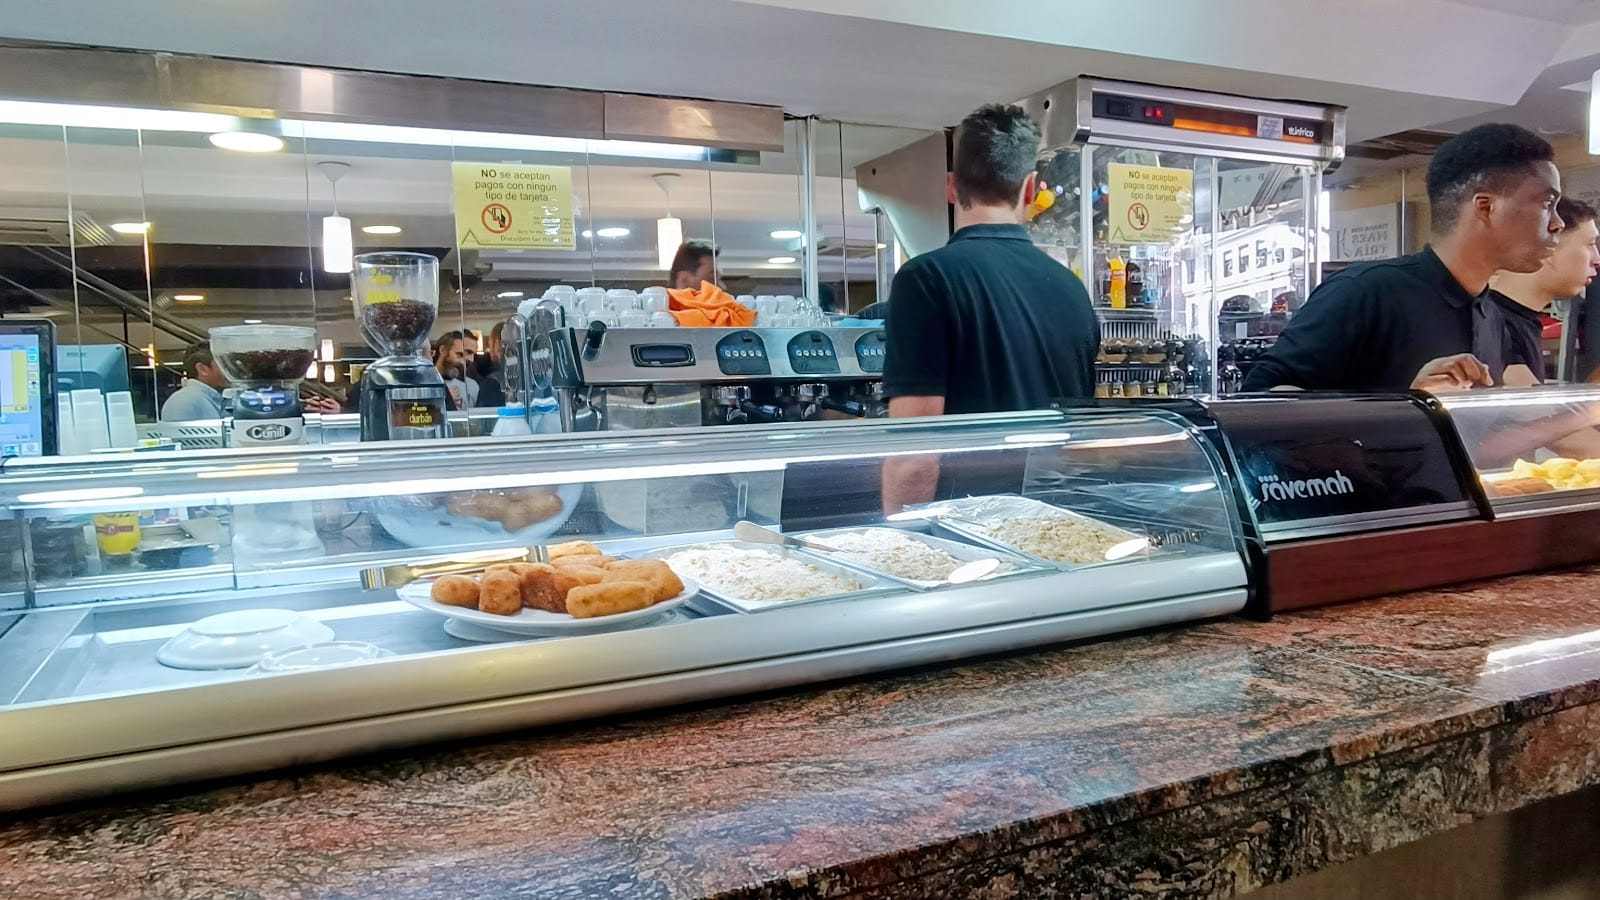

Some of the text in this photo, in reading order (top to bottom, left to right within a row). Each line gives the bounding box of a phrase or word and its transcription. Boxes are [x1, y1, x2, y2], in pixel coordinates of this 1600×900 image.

[481, 169, 551, 181] NO se aceptan
[1128, 171, 1140, 179] NO
[1152, 173, 1178, 183] aceptan
[475, 181, 557, 193] pagos con ningún
[1124, 182, 1145, 190] pagos
[485, 191, 549, 202] tipo de tarjeta
[1131, 192, 1176, 202] tipo de tarjeta
[409, 412, 433, 423] durbán
[252, 425, 286, 439] Cunill
